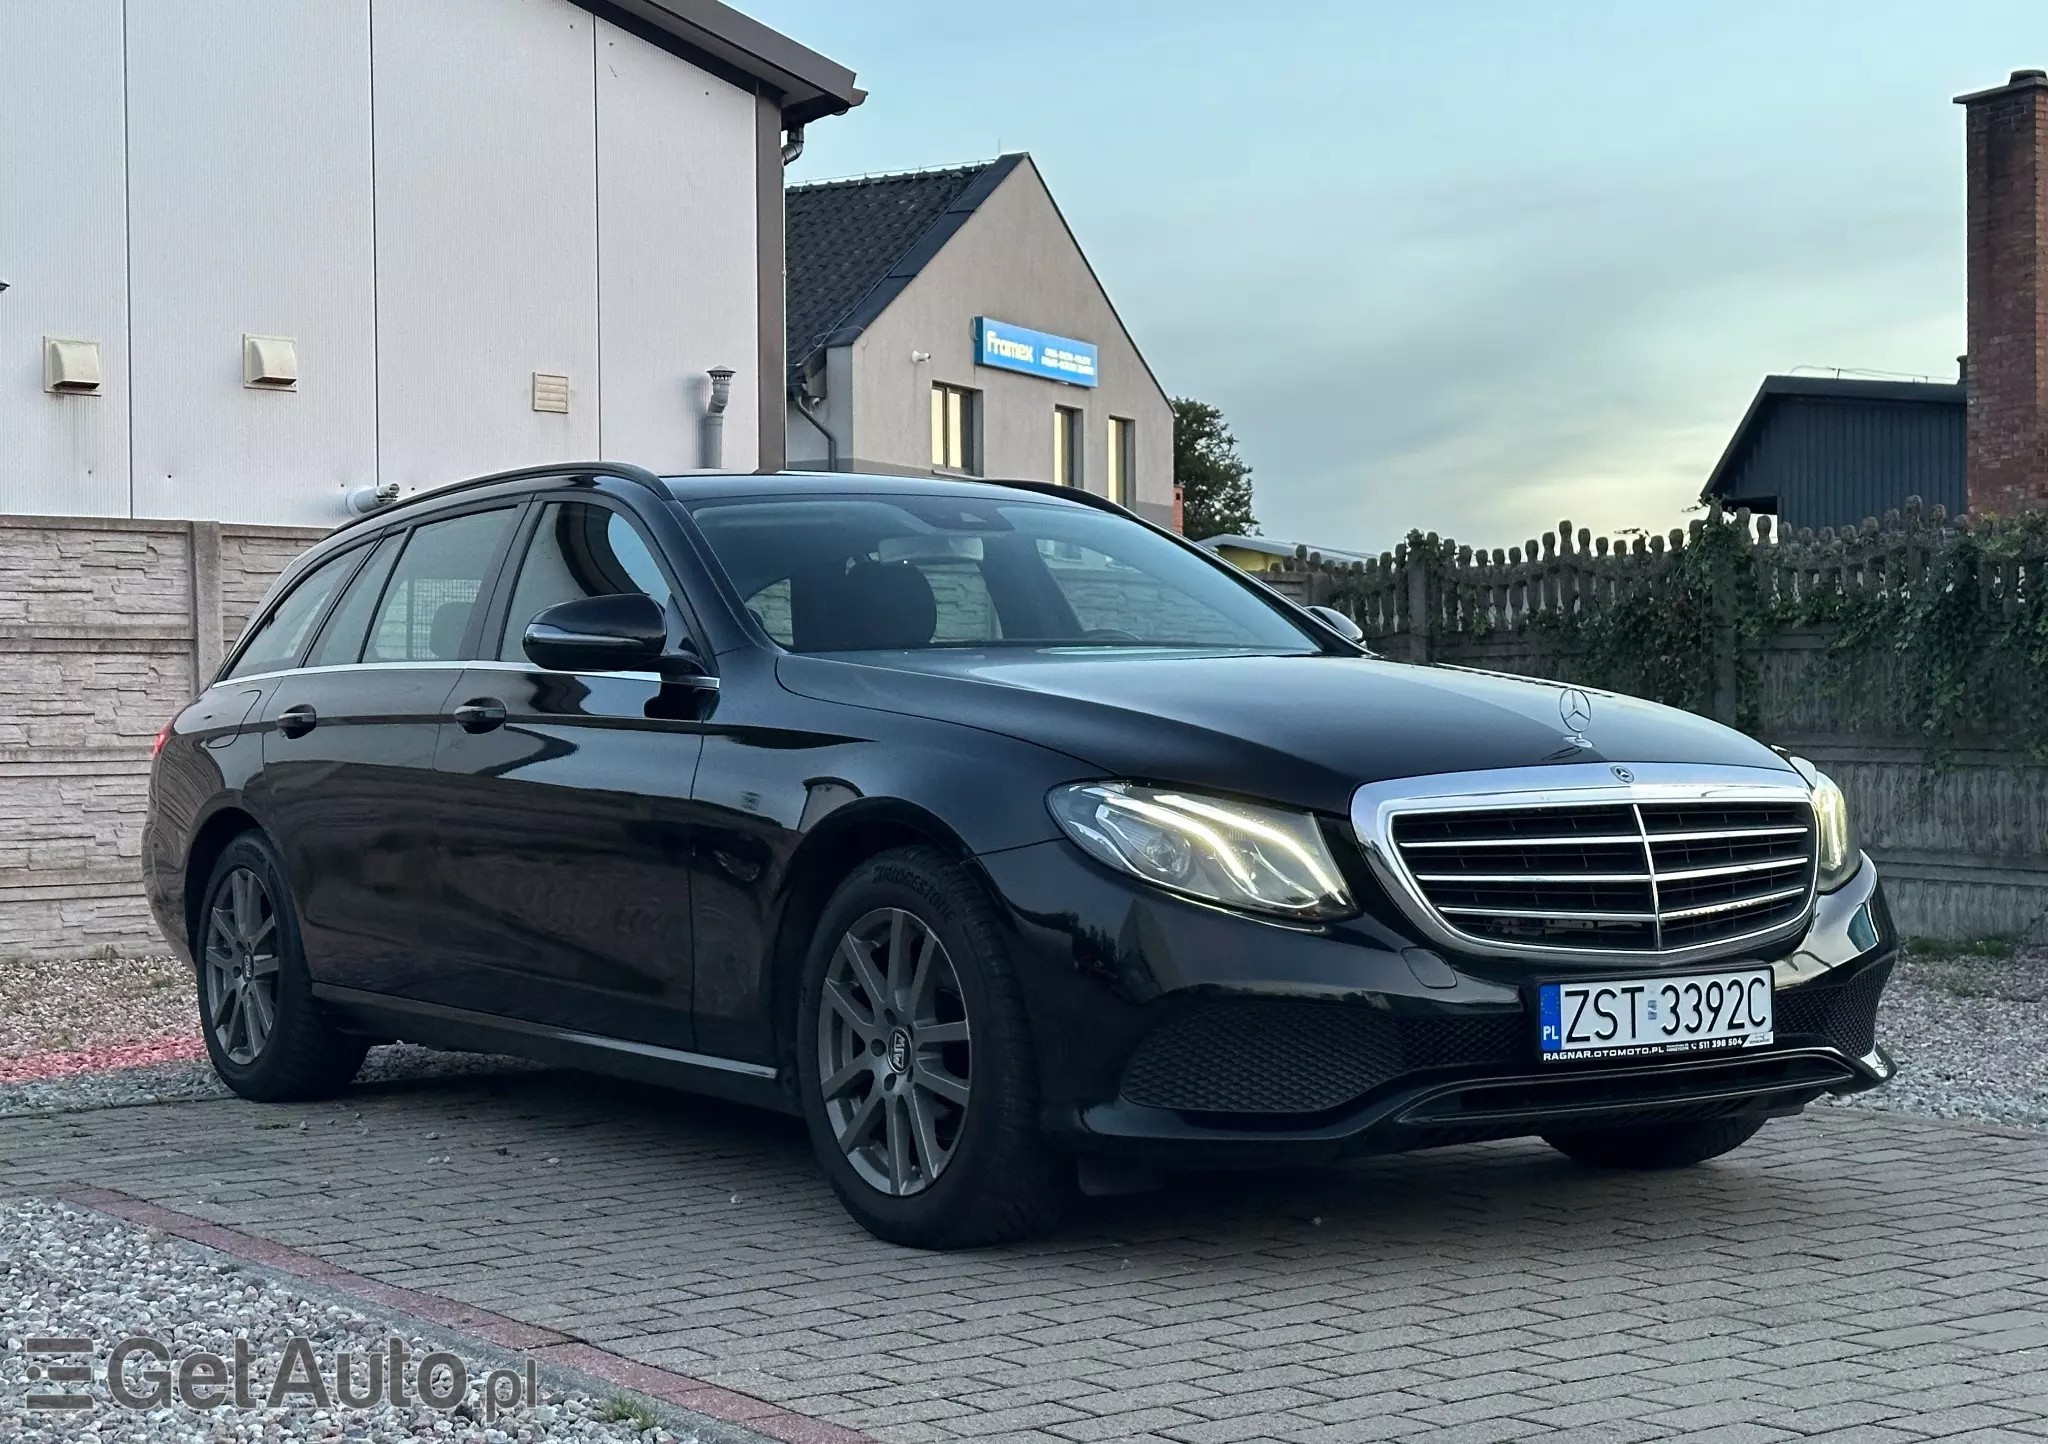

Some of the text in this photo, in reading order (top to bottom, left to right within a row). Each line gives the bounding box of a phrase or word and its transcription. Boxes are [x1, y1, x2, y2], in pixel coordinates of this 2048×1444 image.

[1564, 976, 1767, 1043] ZST 3392C
[1543, 1025, 1559, 1041] PL
[1543, 1046, 1665, 1061] RAGNAR.OTOMOTO.PL
[1698, 1040, 1710, 1049] 511
[1711, 1038, 1726, 1048] 398
[1727, 1037, 1743, 1046] 504
